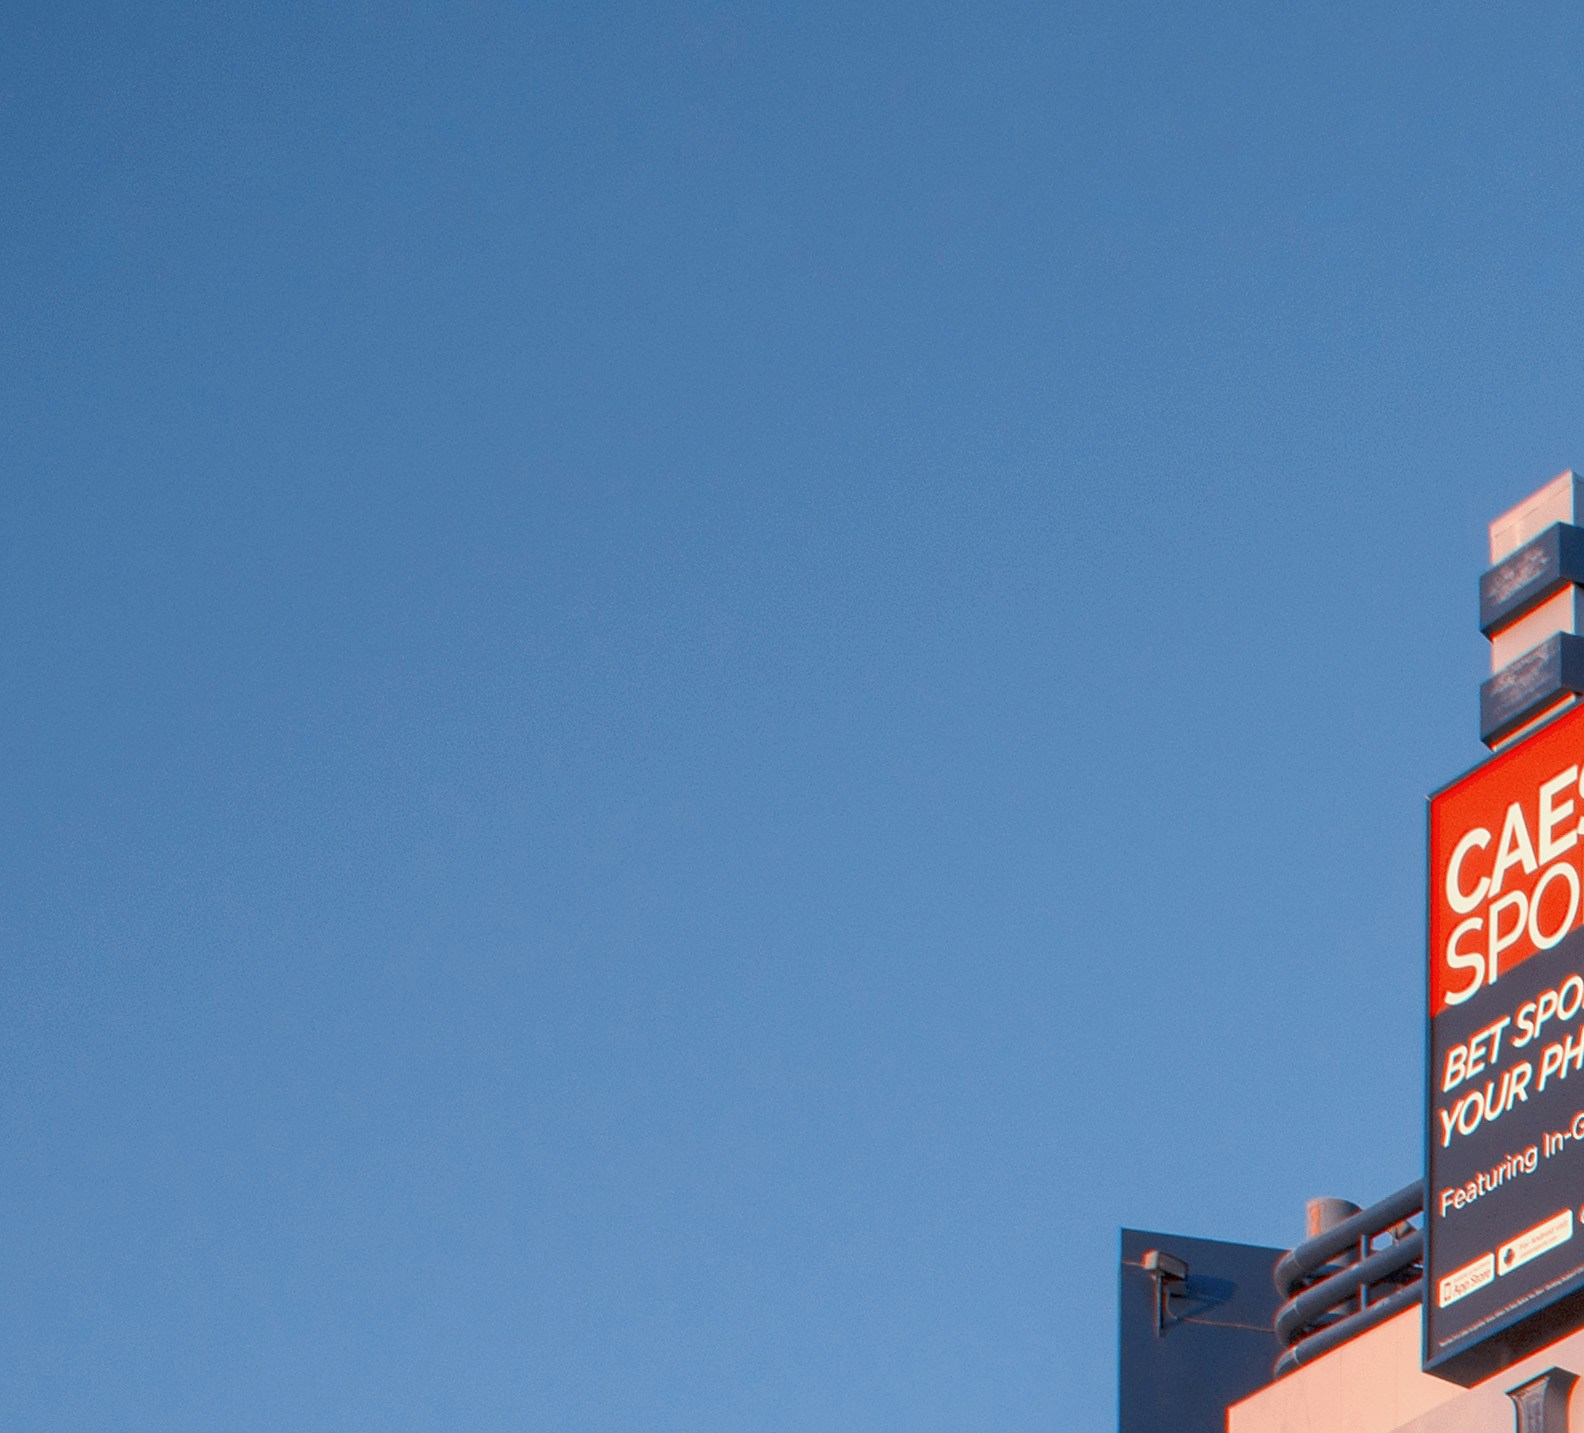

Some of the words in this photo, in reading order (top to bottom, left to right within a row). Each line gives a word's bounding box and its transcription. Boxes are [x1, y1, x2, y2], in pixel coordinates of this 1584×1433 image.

[1441, 1016, 1511, 1092] BET
[1439, 1061, 1532, 1148] YOUR
[1439, 1145, 1538, 1217] Featuring
